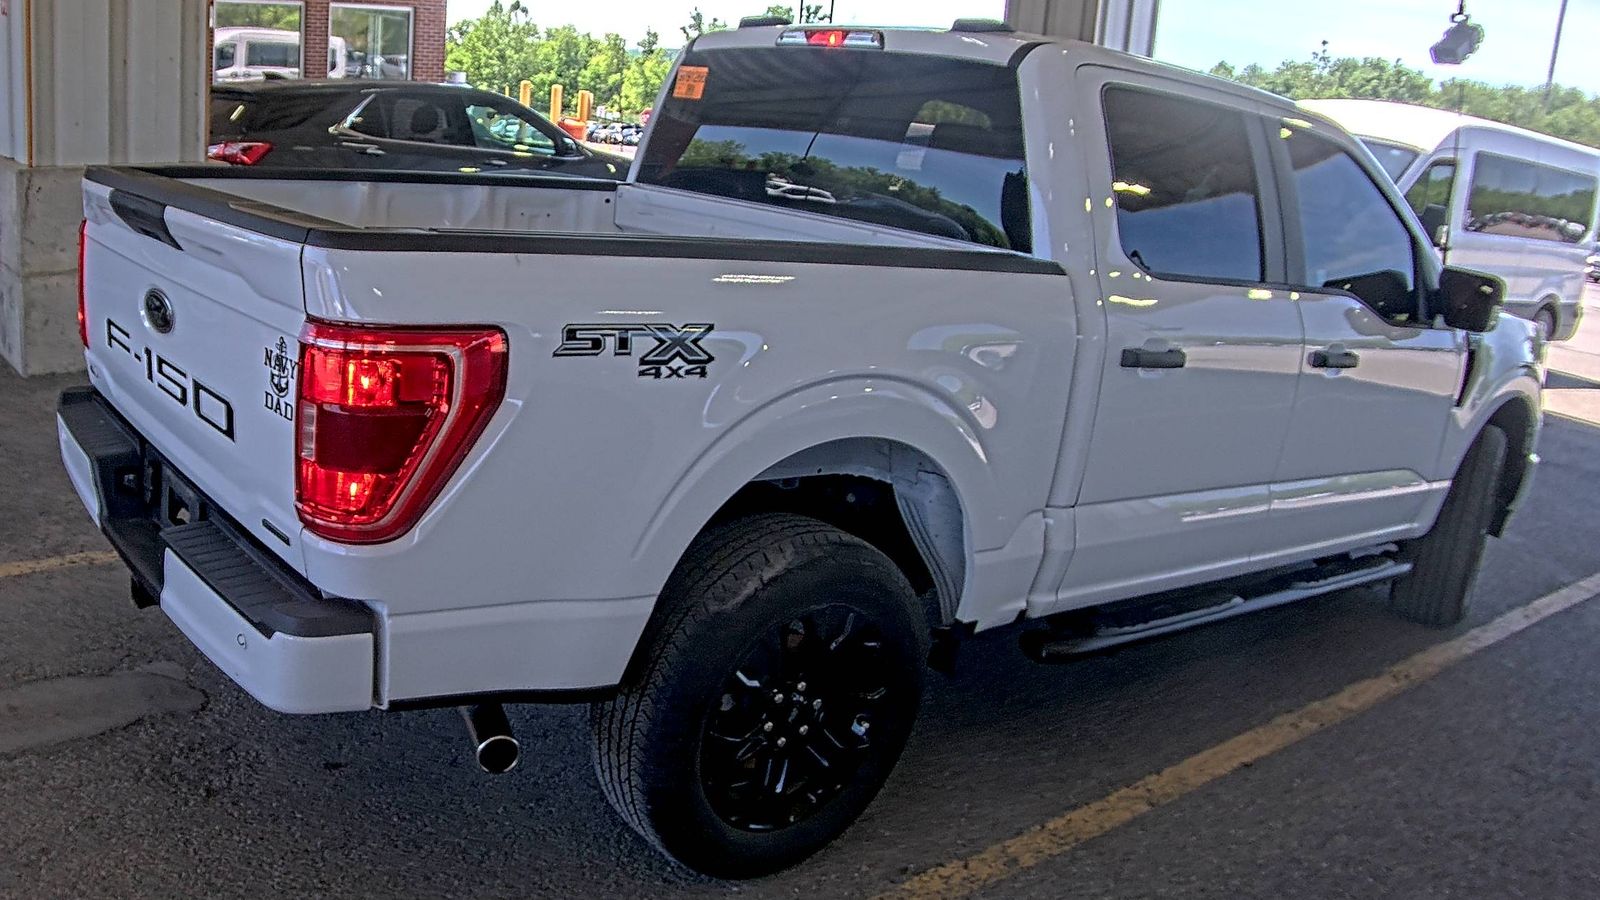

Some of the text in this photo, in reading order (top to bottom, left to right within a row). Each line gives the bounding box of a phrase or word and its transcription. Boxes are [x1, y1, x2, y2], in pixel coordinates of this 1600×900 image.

[264, 346, 298, 380] NAVY
[552, 323, 715, 366] STX
[106, 317, 236, 443] F-150
[264, 390, 294, 421] DAD
